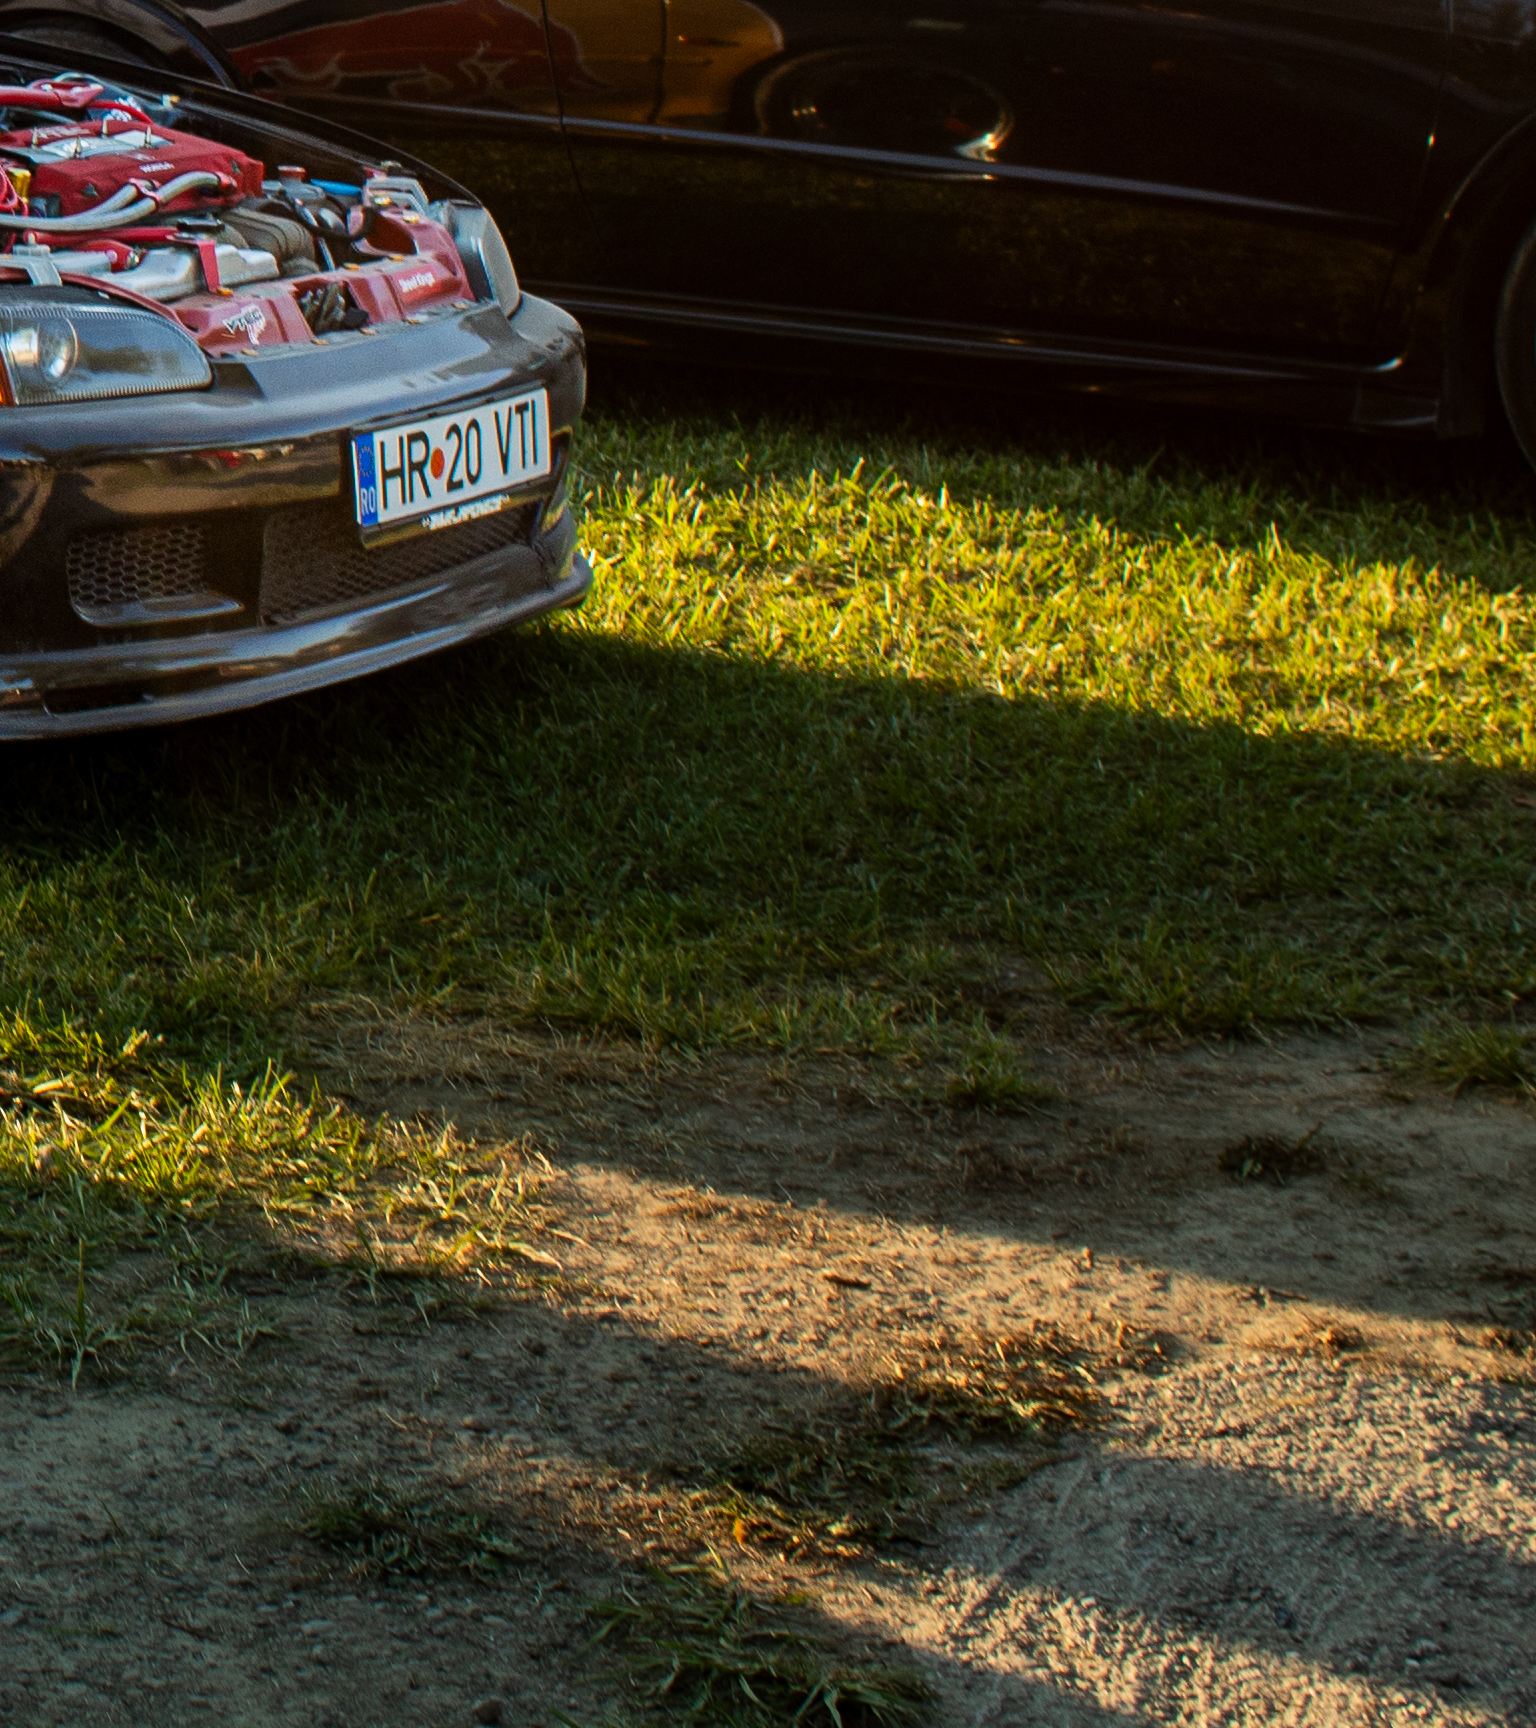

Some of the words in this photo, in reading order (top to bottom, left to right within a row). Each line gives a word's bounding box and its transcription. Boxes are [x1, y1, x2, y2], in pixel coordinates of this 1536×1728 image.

[378, 430, 432, 511] HR
[445, 417, 482, 493] 20
[493, 398, 538, 475] VTI
[359, 487, 376, 516] RO
